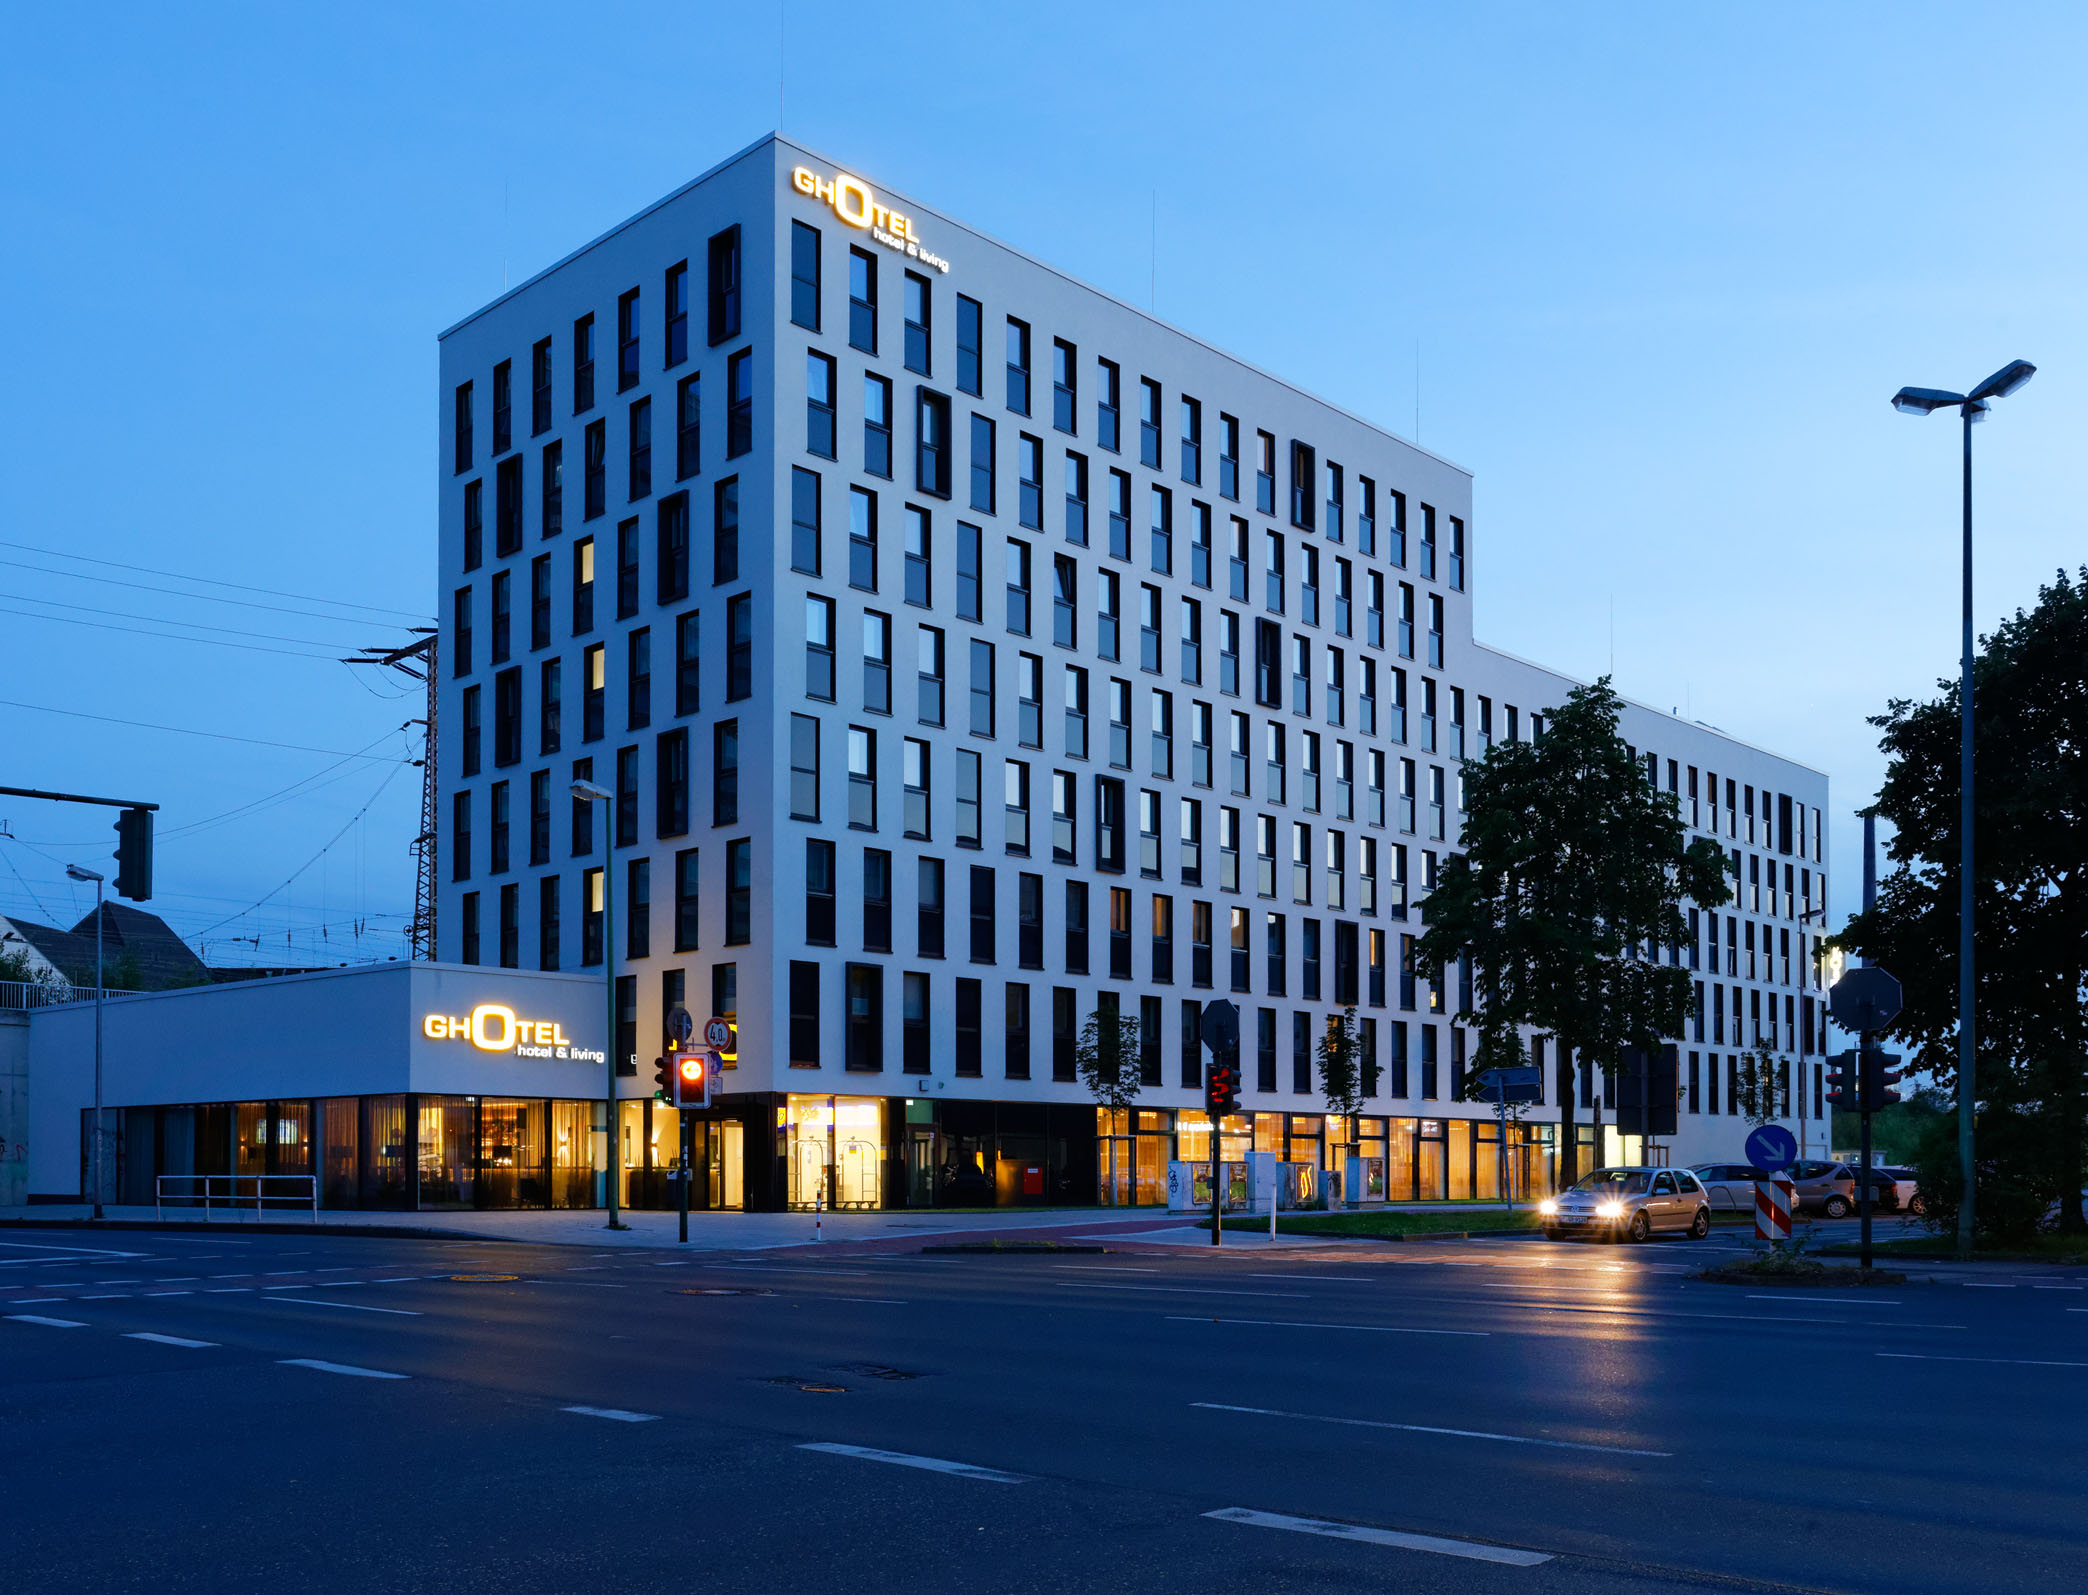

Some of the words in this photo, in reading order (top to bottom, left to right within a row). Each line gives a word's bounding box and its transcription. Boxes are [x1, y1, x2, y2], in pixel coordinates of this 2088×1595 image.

[793, 166, 919, 243] GHOTEL
[873, 227, 904, 250] hotel
[907, 243, 918, 256] &
[920, 249, 949, 274] living
[424, 1004, 570, 1050] GHOTEL
[517, 1045, 551, 1058] hotel
[556, 1047, 567, 1058] &
[571, 1048, 604, 1063] living
